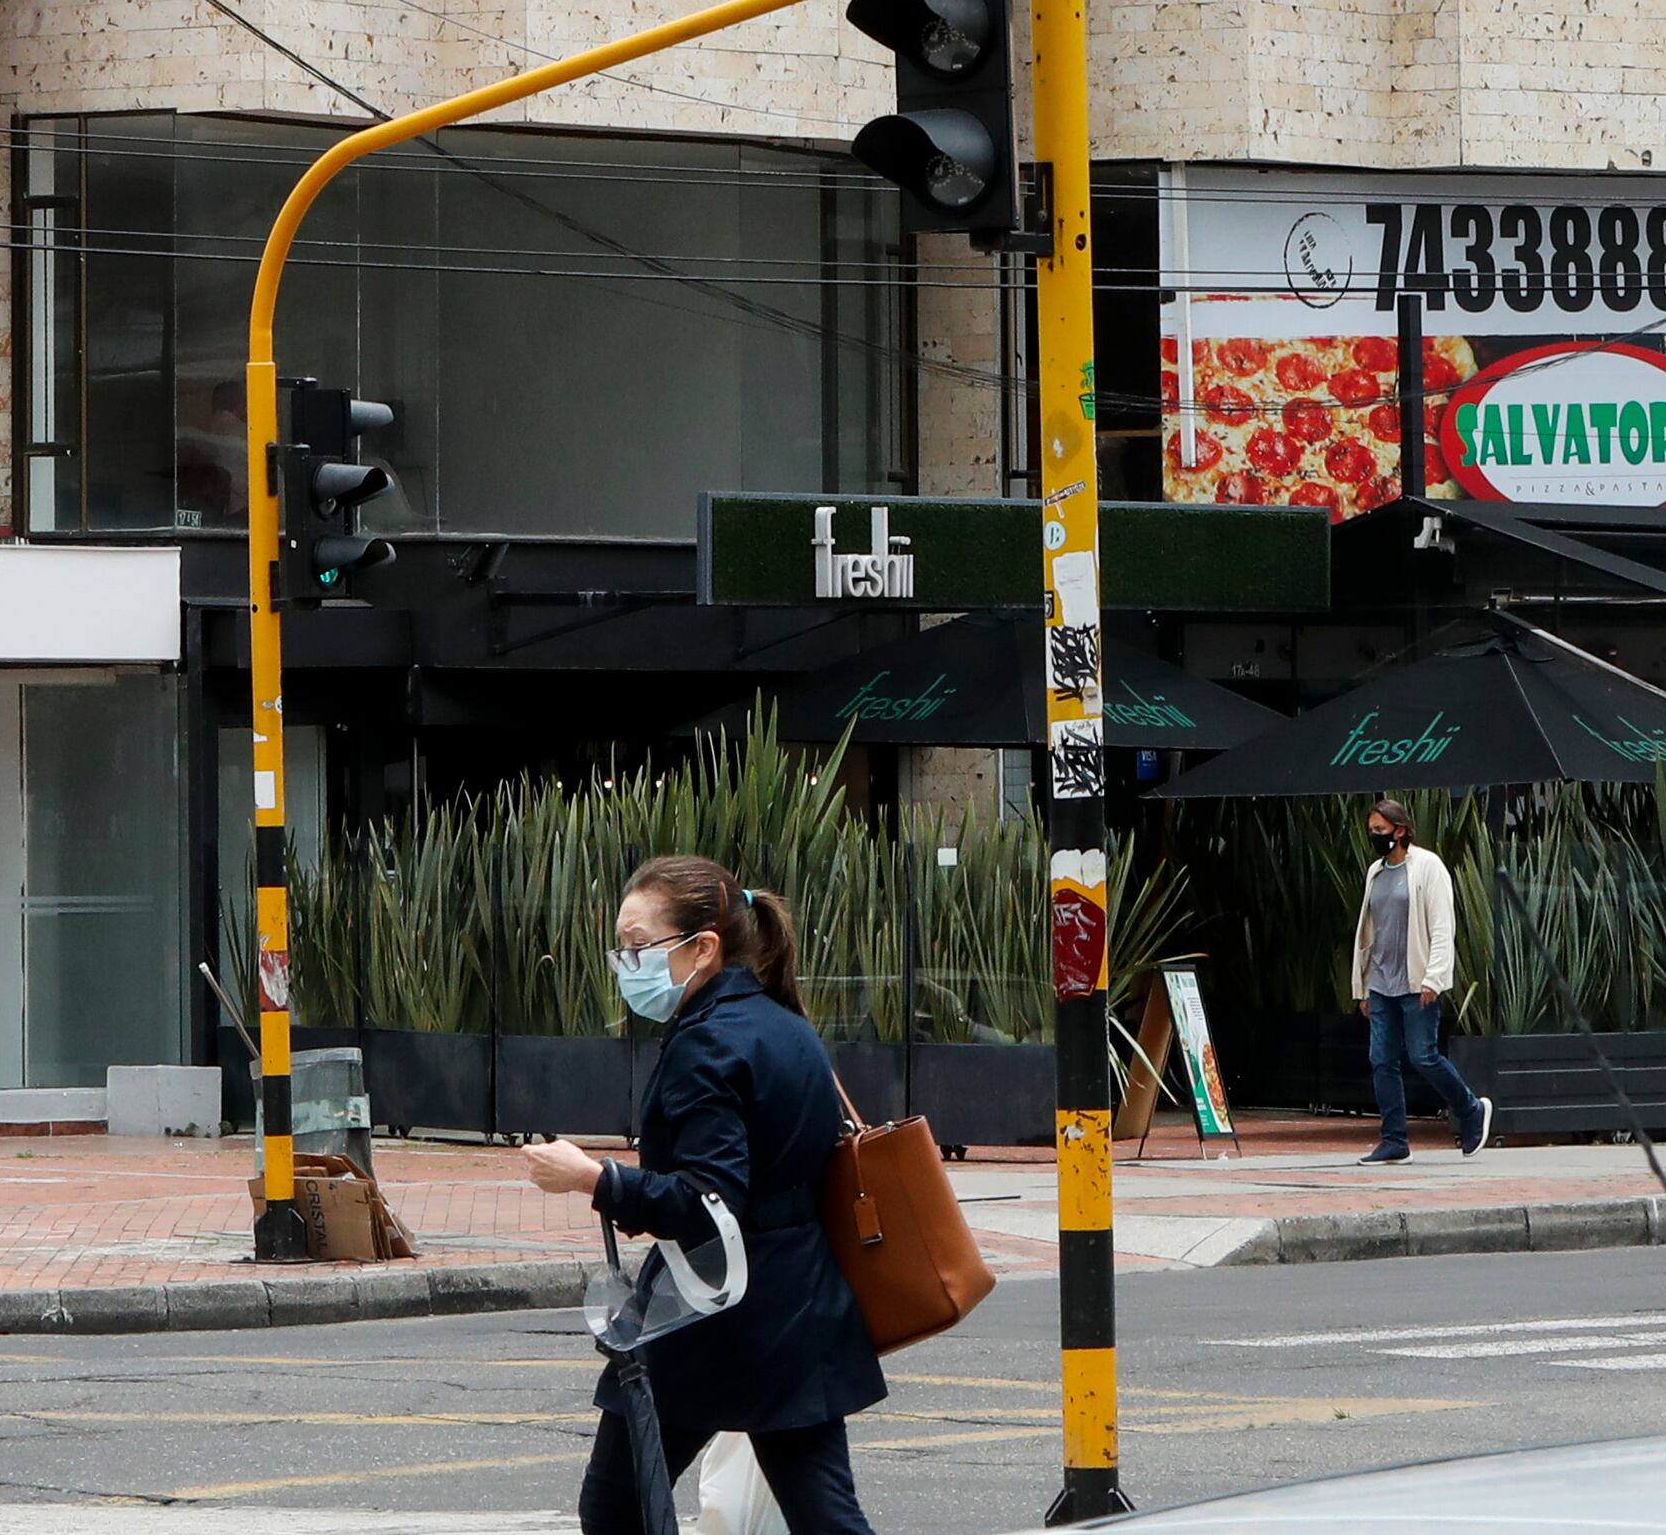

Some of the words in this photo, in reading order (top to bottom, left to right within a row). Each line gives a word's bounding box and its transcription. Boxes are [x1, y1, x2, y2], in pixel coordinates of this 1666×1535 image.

[811, 507, 913, 598] freshii
[835, 670, 957, 720] freshii
[1331, 711, 1461, 766] freshii
[306, 1179, 328, 1250] CRISTAL
